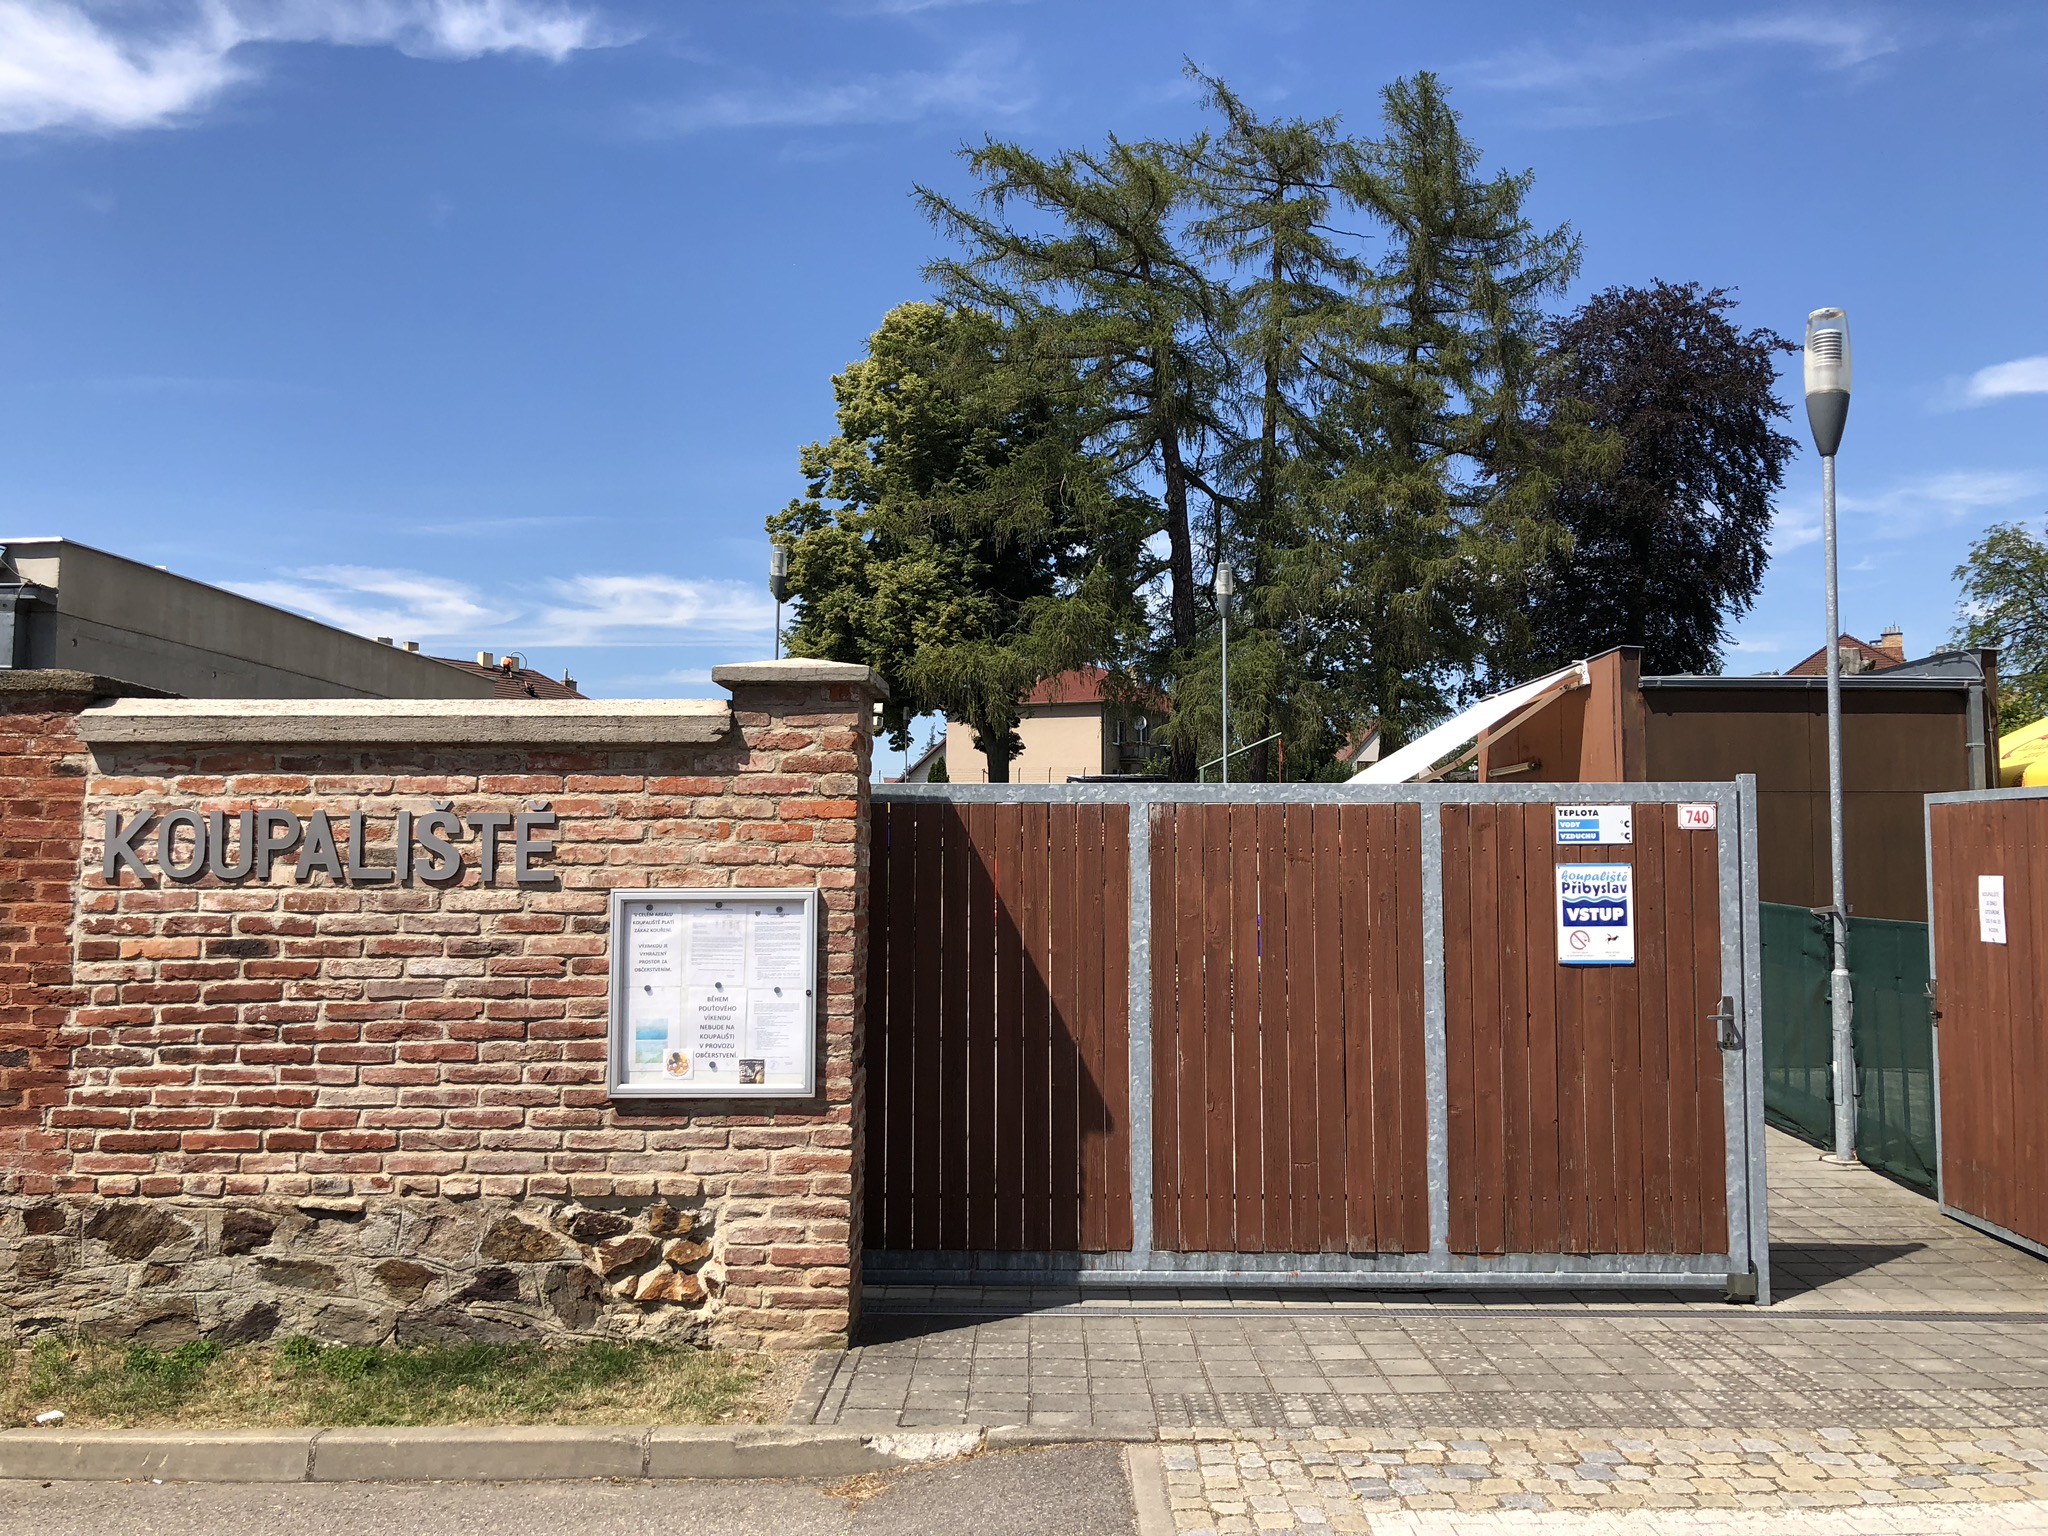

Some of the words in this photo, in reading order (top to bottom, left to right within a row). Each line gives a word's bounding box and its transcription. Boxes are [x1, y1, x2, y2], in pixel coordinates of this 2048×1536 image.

[1558, 809, 1599, 817] TEPLOTA
[1686, 810, 1709, 825] 740
[103, 800, 556, 882] KOUPALIŠTĚ
[1561, 870, 1628, 882] koupaliště
[1561, 881, 1627, 897] Přibyslav
[1565, 907, 1625, 922] VSTUP
